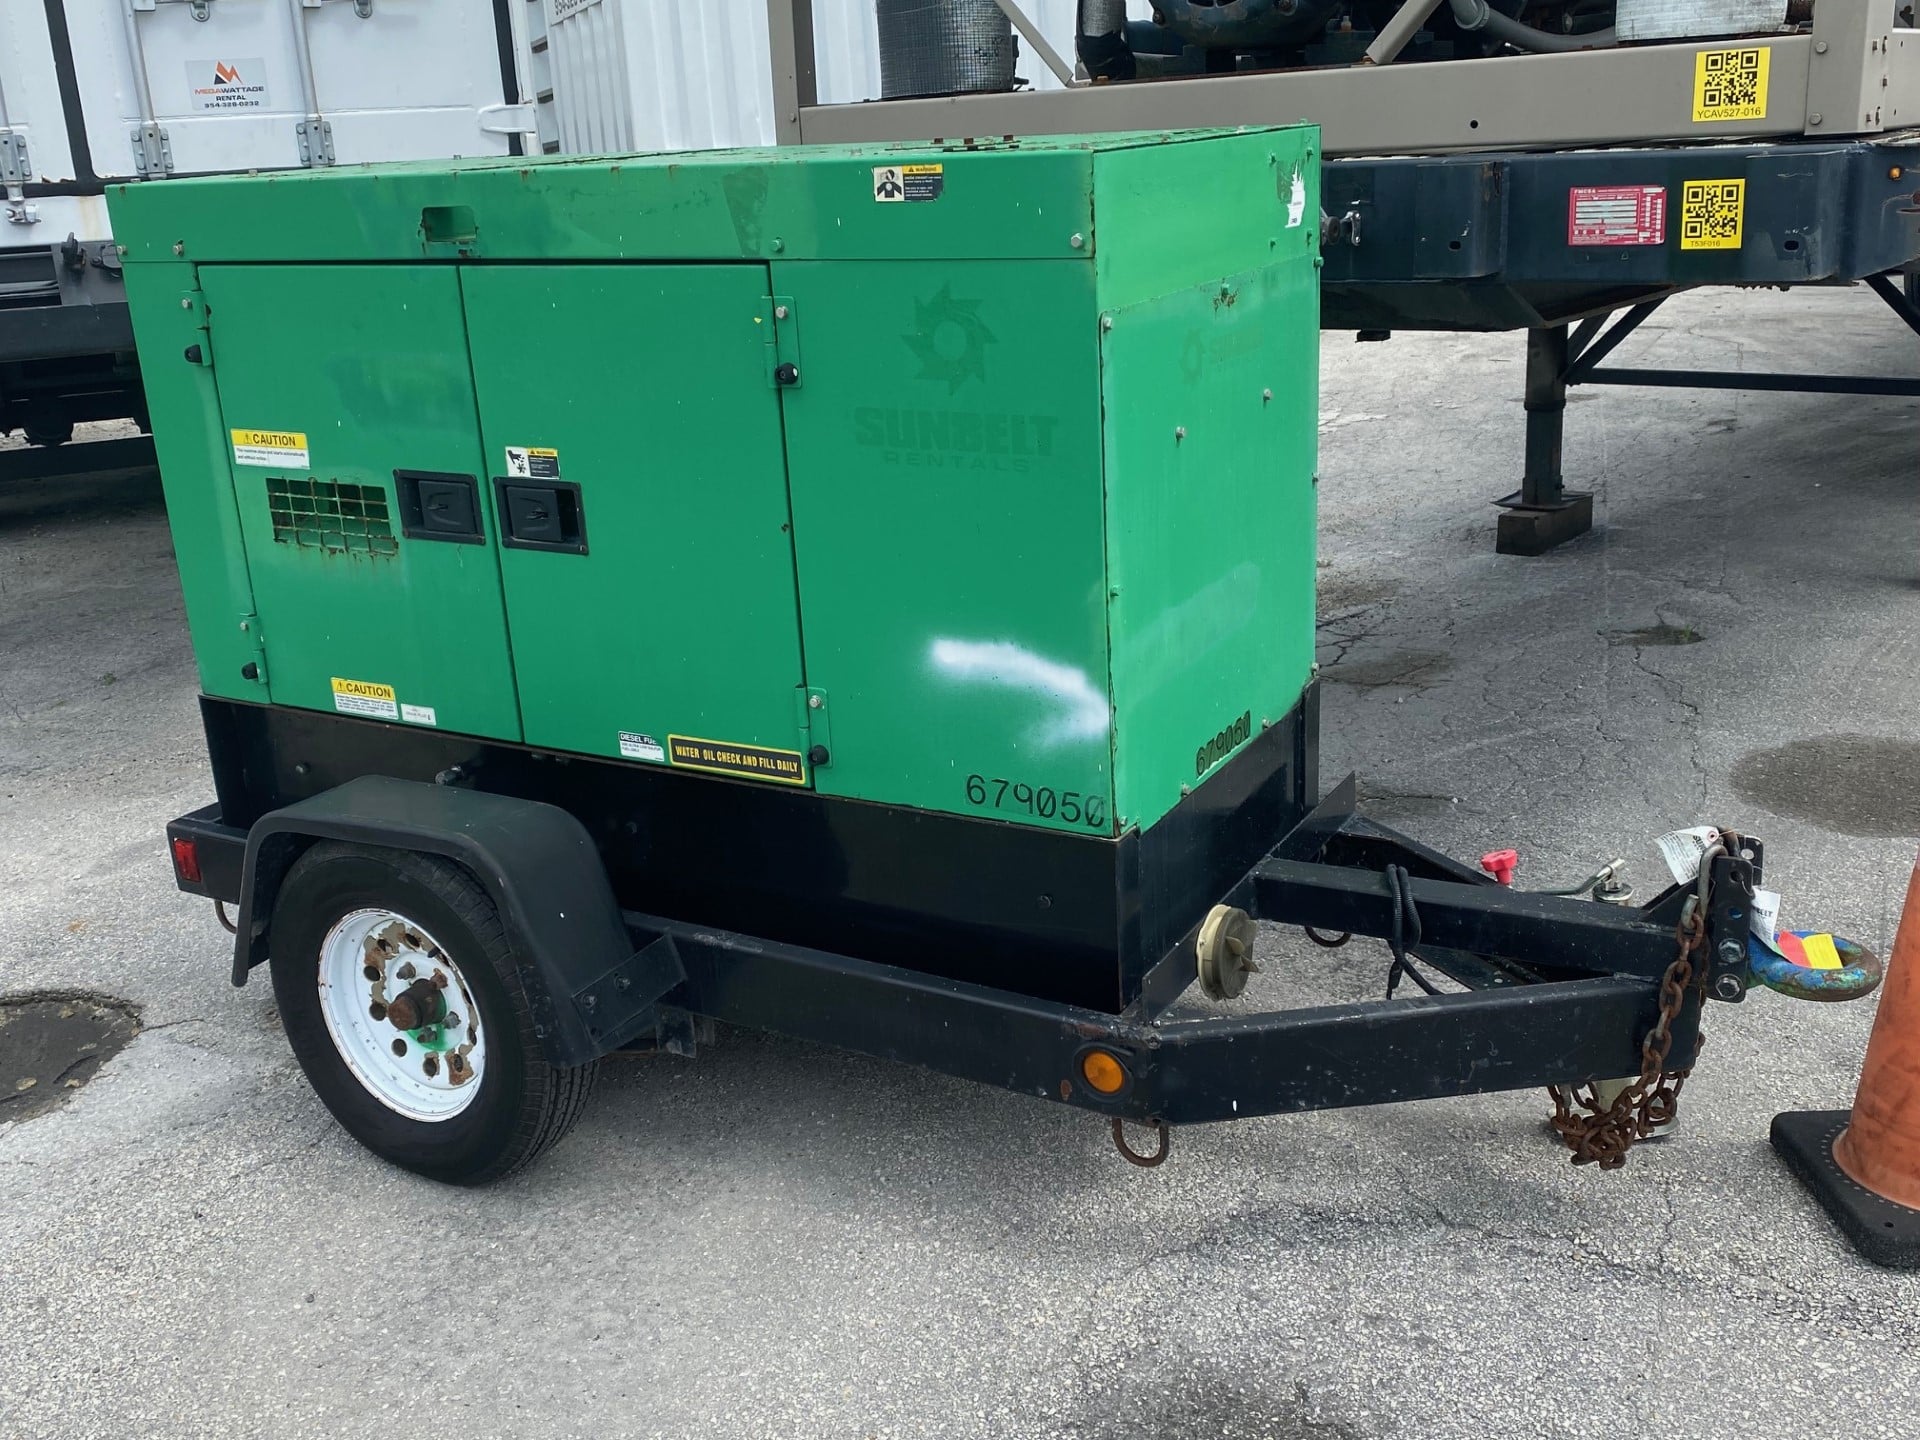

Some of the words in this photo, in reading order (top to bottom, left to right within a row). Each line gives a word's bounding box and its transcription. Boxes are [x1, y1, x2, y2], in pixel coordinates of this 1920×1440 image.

[194, 86, 265, 95] MEGAWATTAGE
[1697, 107, 1761, 119] YCAV527-016
[252, 433, 297, 447] CAUTION
[346, 682, 392, 698] CAUTION
[620, 733, 643, 743] DIESEL
[1196, 709, 1251, 777] 679050
[675, 745, 700, 759] WATER
[703, 750, 716, 761] OIL
[717, 751, 742, 764] CHECK
[743, 755, 758, 767] AND
[759, 757, 776, 770] FILL
[776, 759, 798, 773] DAILY
[966, 774, 1105, 828] 679050
